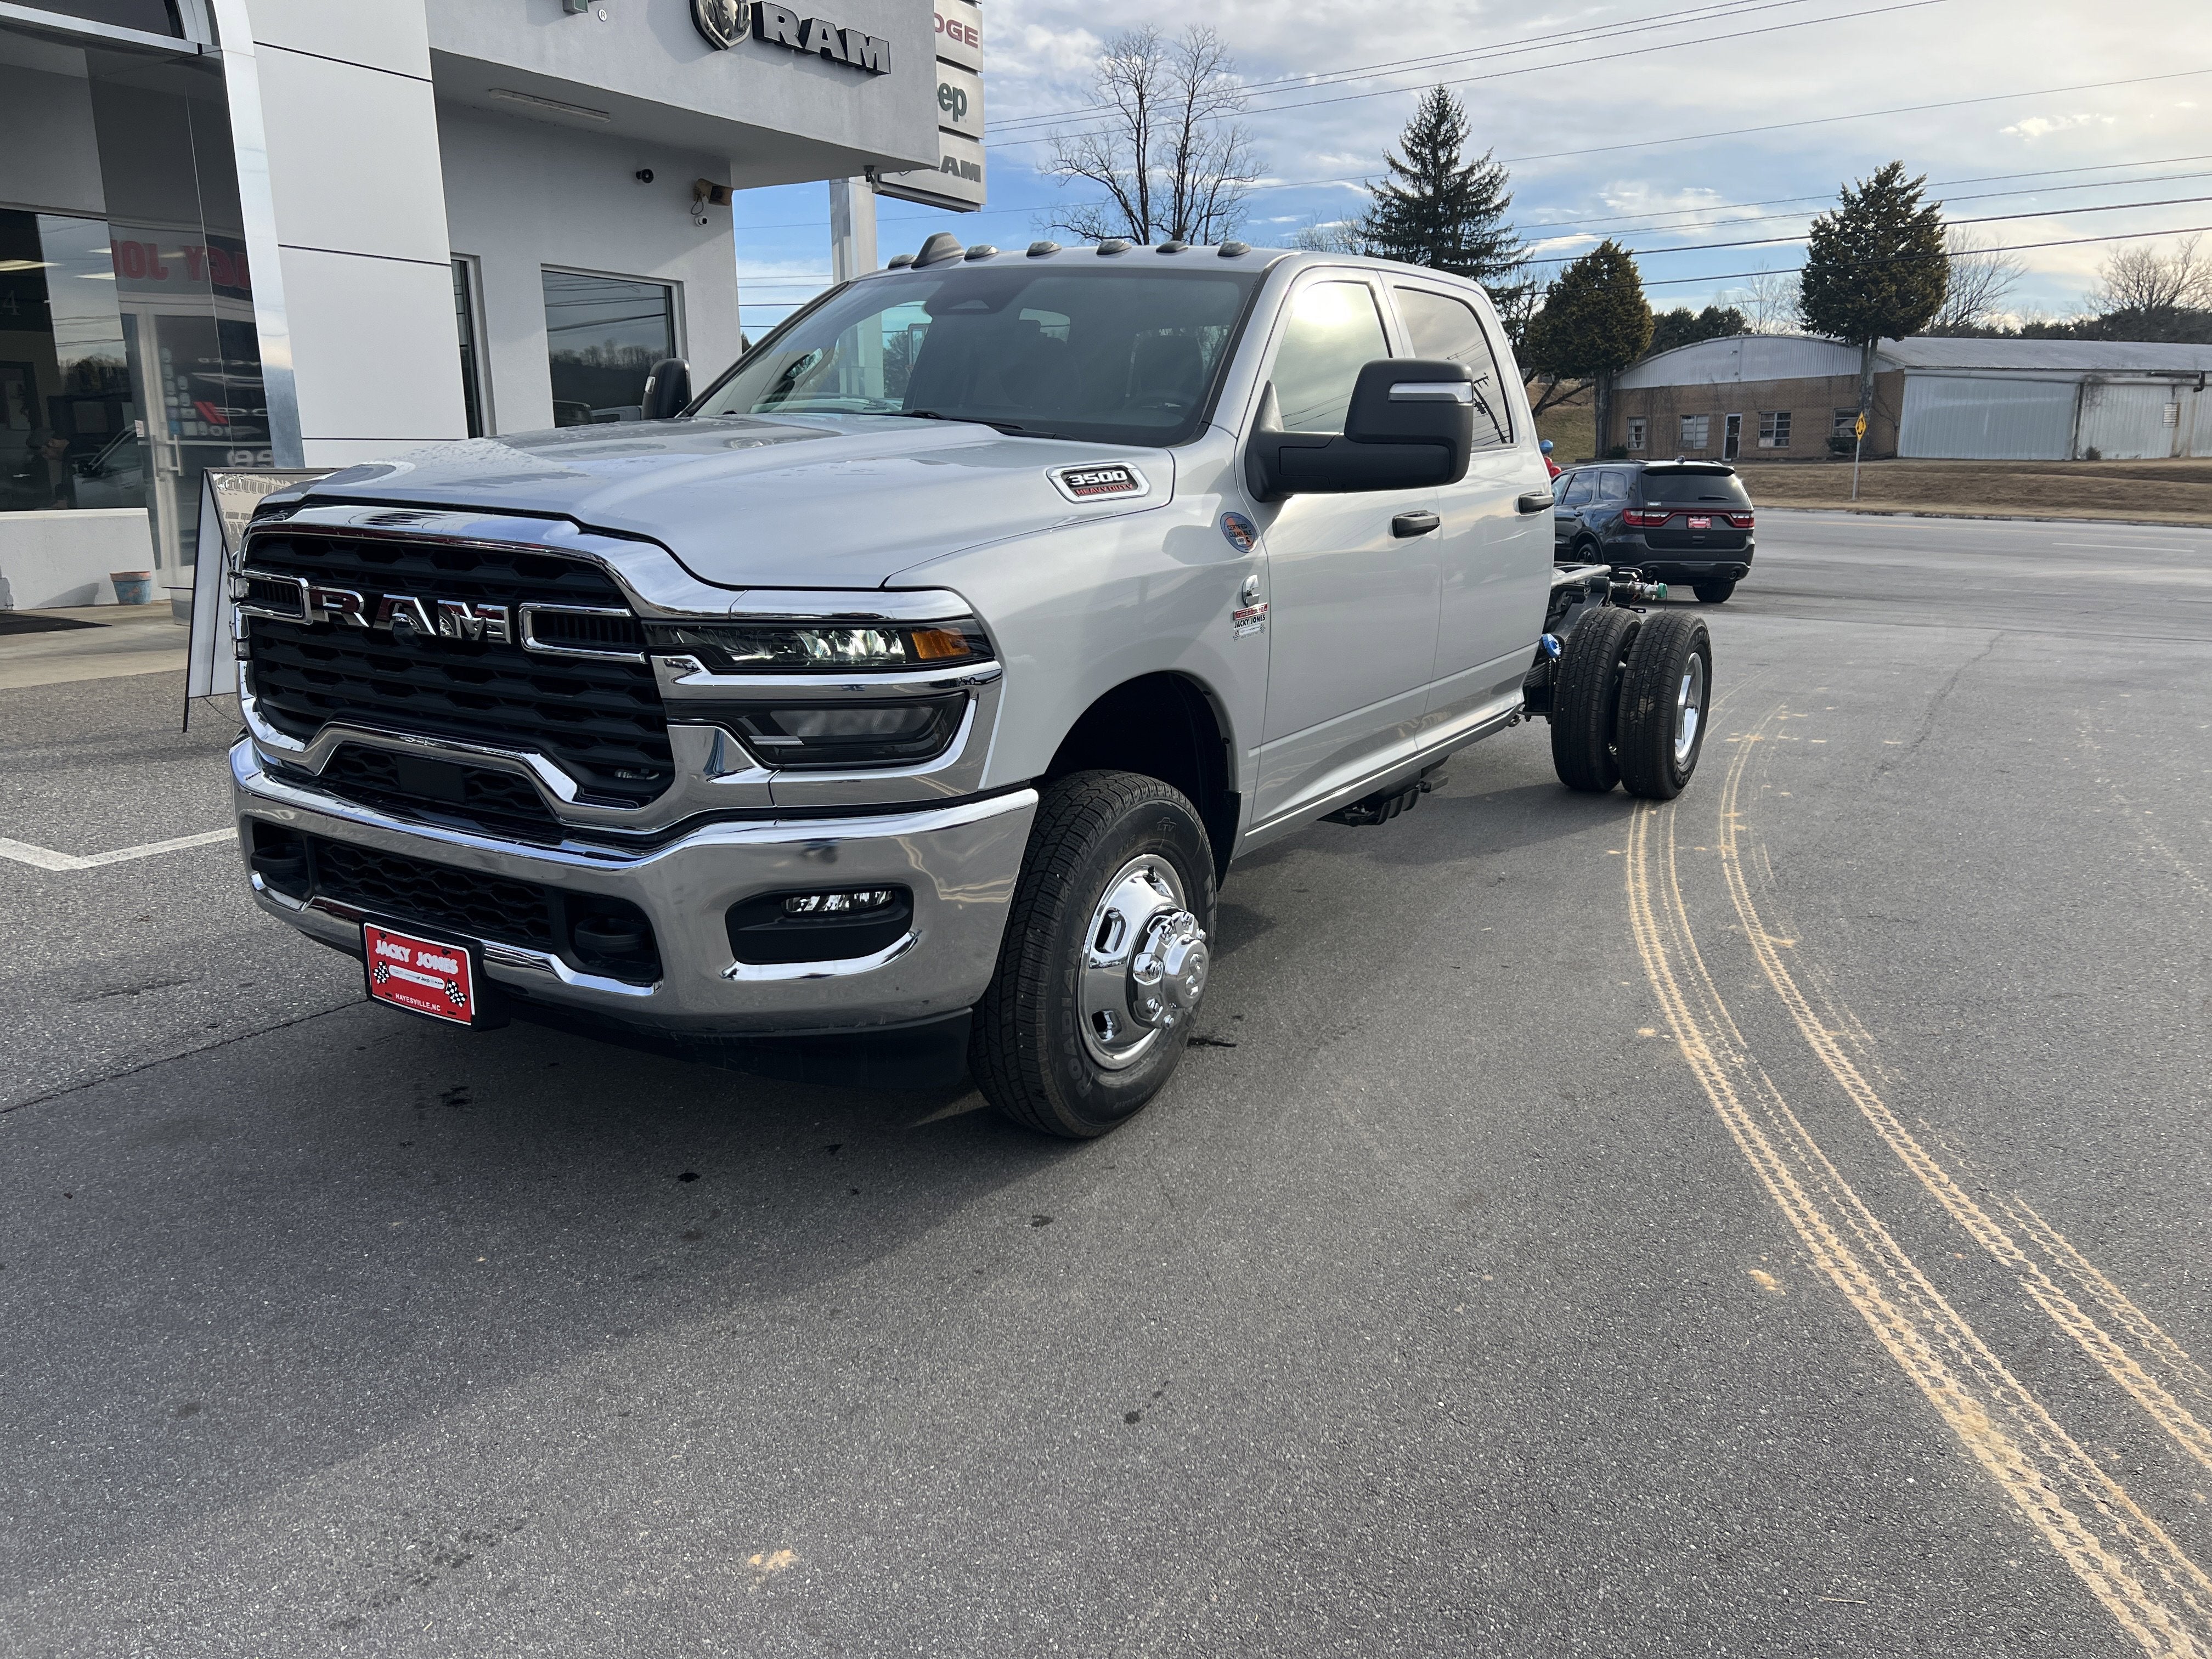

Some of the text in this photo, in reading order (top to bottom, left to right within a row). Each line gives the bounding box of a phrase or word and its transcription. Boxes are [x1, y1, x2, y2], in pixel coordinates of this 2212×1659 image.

[752, 1, 890, 75] RAM
[937, 82, 967, 122] ep
[939, 155, 981, 183] AM
[1068, 470, 1128, 486] 3500
[1075, 486, 1107, 495] HEAVY
[308, 585, 512, 645] RAM
[1234, 614, 1265, 629] JACKY JONES
[375, 939, 459, 974] JACKY JONES
